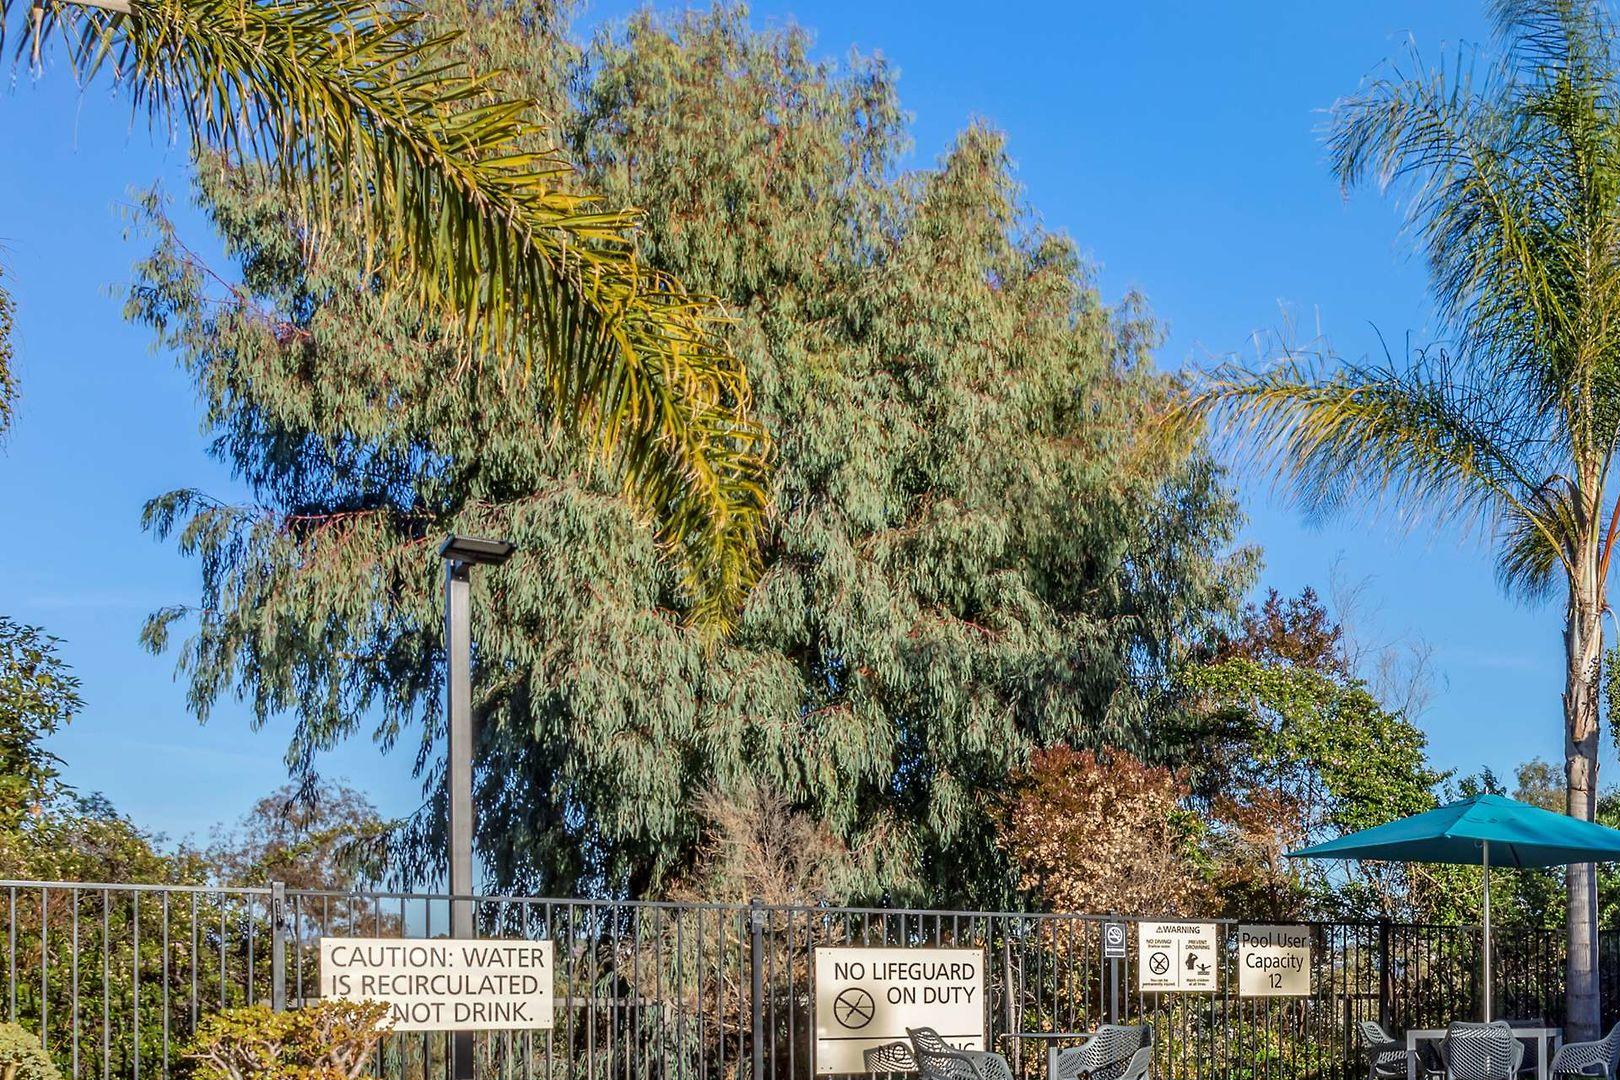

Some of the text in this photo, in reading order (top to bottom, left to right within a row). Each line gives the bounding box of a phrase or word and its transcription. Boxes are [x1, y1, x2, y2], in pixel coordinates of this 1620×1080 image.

[1163, 925, 1200, 934] WARNING
[1242, 932, 1307, 949] Pool User
[331, 946, 545, 968] CAUTION: WATER
[1246, 952, 1304, 972] Capacity
[834, 962, 975, 981] NO LIFEGUARD
[1268, 973, 1283, 989] 12
[332, 974, 544, 996] IS RECIRCULATED.
[887, 986, 976, 1005] ON DUTY
[393, 1001, 534, 1023] NOT DRINK.
